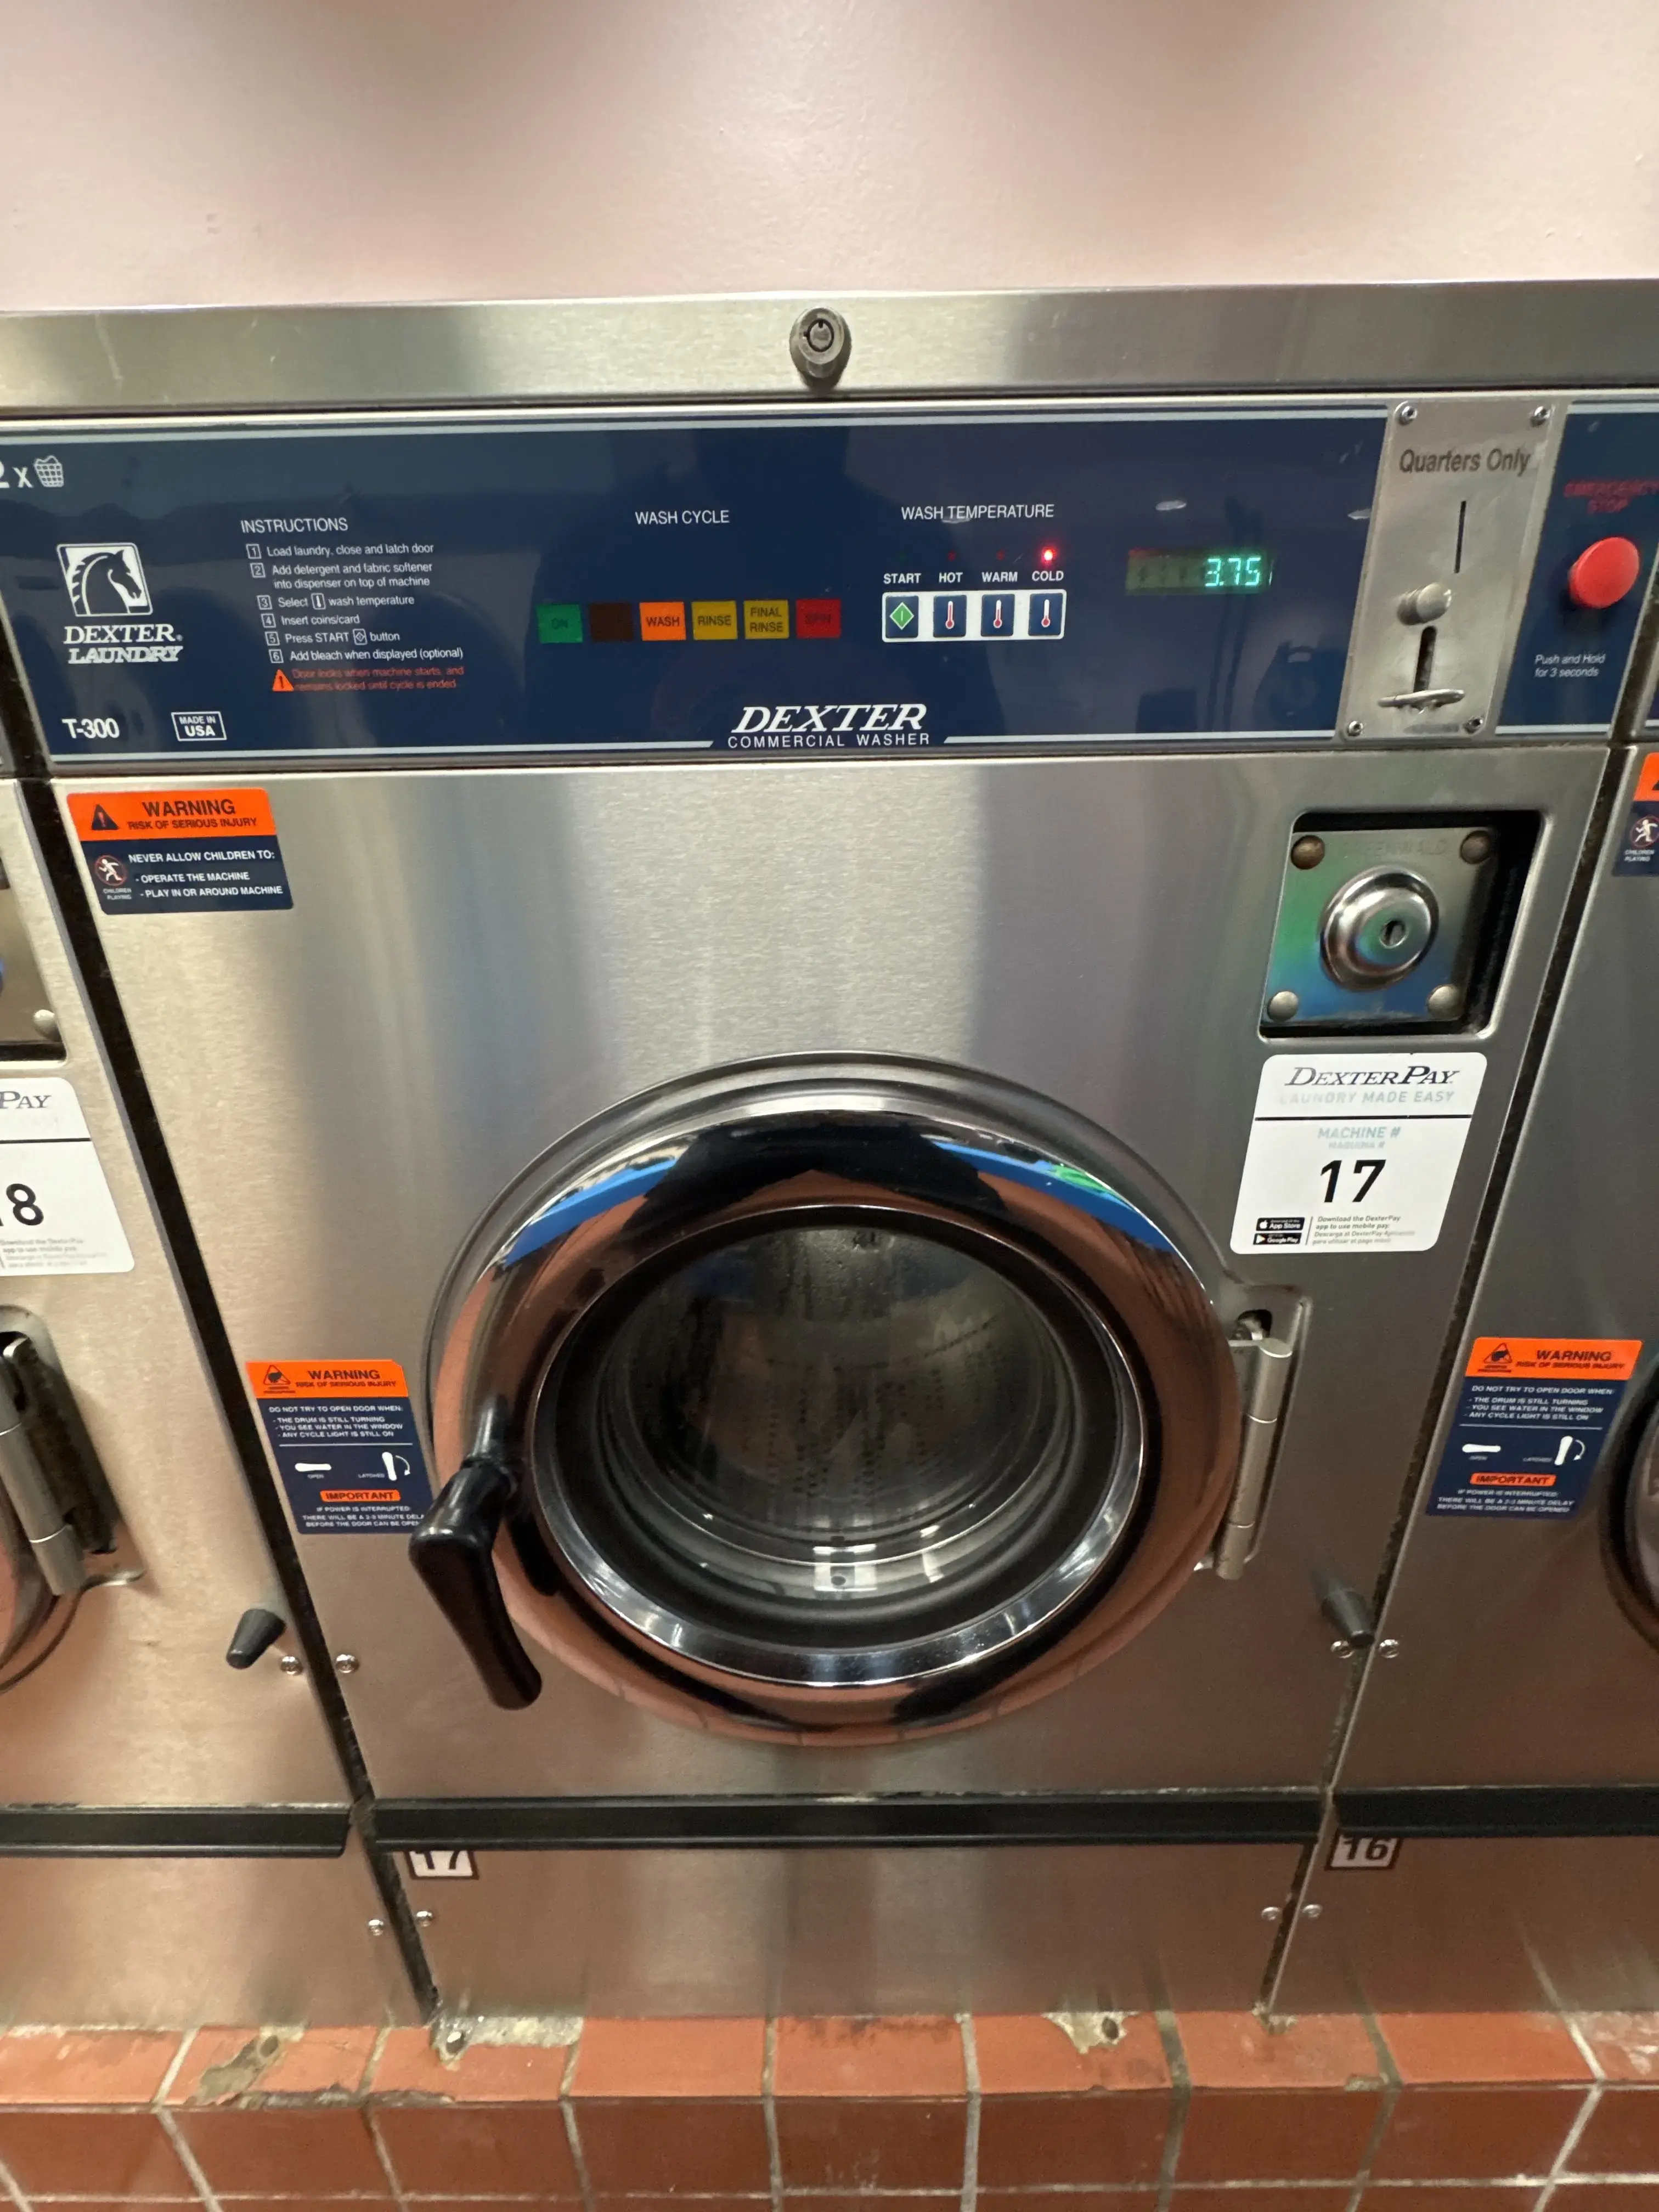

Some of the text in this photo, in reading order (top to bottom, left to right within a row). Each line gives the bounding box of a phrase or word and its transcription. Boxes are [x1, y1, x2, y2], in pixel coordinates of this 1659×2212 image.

[1400, 448, 1531, 477] Quarters Only
[635, 510, 730, 524] WASH CYCLE
[901, 504, 1054, 520] WASH TEMPERATURE
[240, 517, 348, 533] INSTRUCTIONS
[267, 546, 292, 557] Load
[336, 545, 362, 555] close
[364, 545, 383, 555] and
[385, 544, 409, 554] latch
[411, 544, 433, 553] door
[273, 565, 291, 575] Add
[294, 565, 340, 577] detergent
[343, 564, 360, 574] and
[363, 563, 391, 573] fabric
[393, 562, 432, 573] softener
[1205, 557, 1261, 586] 3.75
[883, 573, 921, 584] START
[939, 572, 963, 583] HOT
[981, 571, 1018, 583] WARM
[1031, 571, 1064, 582] COLD
[274, 577, 430, 591] into dispenser on top of machine
[278, 597, 308, 608] Select
[329, 596, 354, 606] wash
[357, 595, 414, 607] temperature
[751, 606, 781, 617] FINAL
[281, 616, 308, 626] Insert
[311, 614, 360, 625] coins/card
[646, 616, 680, 627] WASH
[697, 615, 731, 627] RINSE
[749, 622, 783, 633] RINSE
[285, 634, 313, 644] Press
[315, 633, 349, 642] START
[370, 632, 400, 642] button
[68, 646, 183, 664] LAUNDRY
[290, 651, 309, 661] Add
[311, 650, 342, 661] bleach
[345, 650, 370, 659] when
[372, 648, 417, 661] displayed
[420, 647, 463, 659] (optional)
[1535, 653, 1606, 664] Push and Hold
[373, 667, 411, 676] machine
[447, 666, 464, 675] and
[1535, 667, 1599, 678] for 3 seconds
[390, 680, 414, 691] cycle
[416, 680, 425, 689] is
[427, 679, 456, 689] ended
[179, 716, 205, 725] MADE
[730, 703, 927, 733] DEXTER
[62, 718, 120, 738] T-300
[184, 725, 215, 737] USA
[728, 733, 929, 749] COMMERCIAL WASHER
[142, 799, 235, 817] WARNING
[128, 817, 257, 830] RISK OF SERIOUS INJURY
[128, 850, 275, 864] NEVER ALLOW CHILDREN TO:
[140, 872, 250, 884] OPERATE THE MACHINE
[145, 885, 283, 898] PLAY IN OR AROUND MACHINE
[1280, 1091, 1454, 1105] LAUNDRY MADE EASY
[1317, 1126, 1401, 1139] MACHINE #
[1320, 1159, 1386, 1203] 17
[0, 1183, 44, 1226] 8
[1536, 1350, 1612, 1361] WARNING
[307, 1369, 381, 1380] WARNING
[1476, 1475, 1550, 1485] IMPORTANT
[325, 1492, 393, 1500] IMPORTANT
[1344, 1838, 1389, 1860] 16
